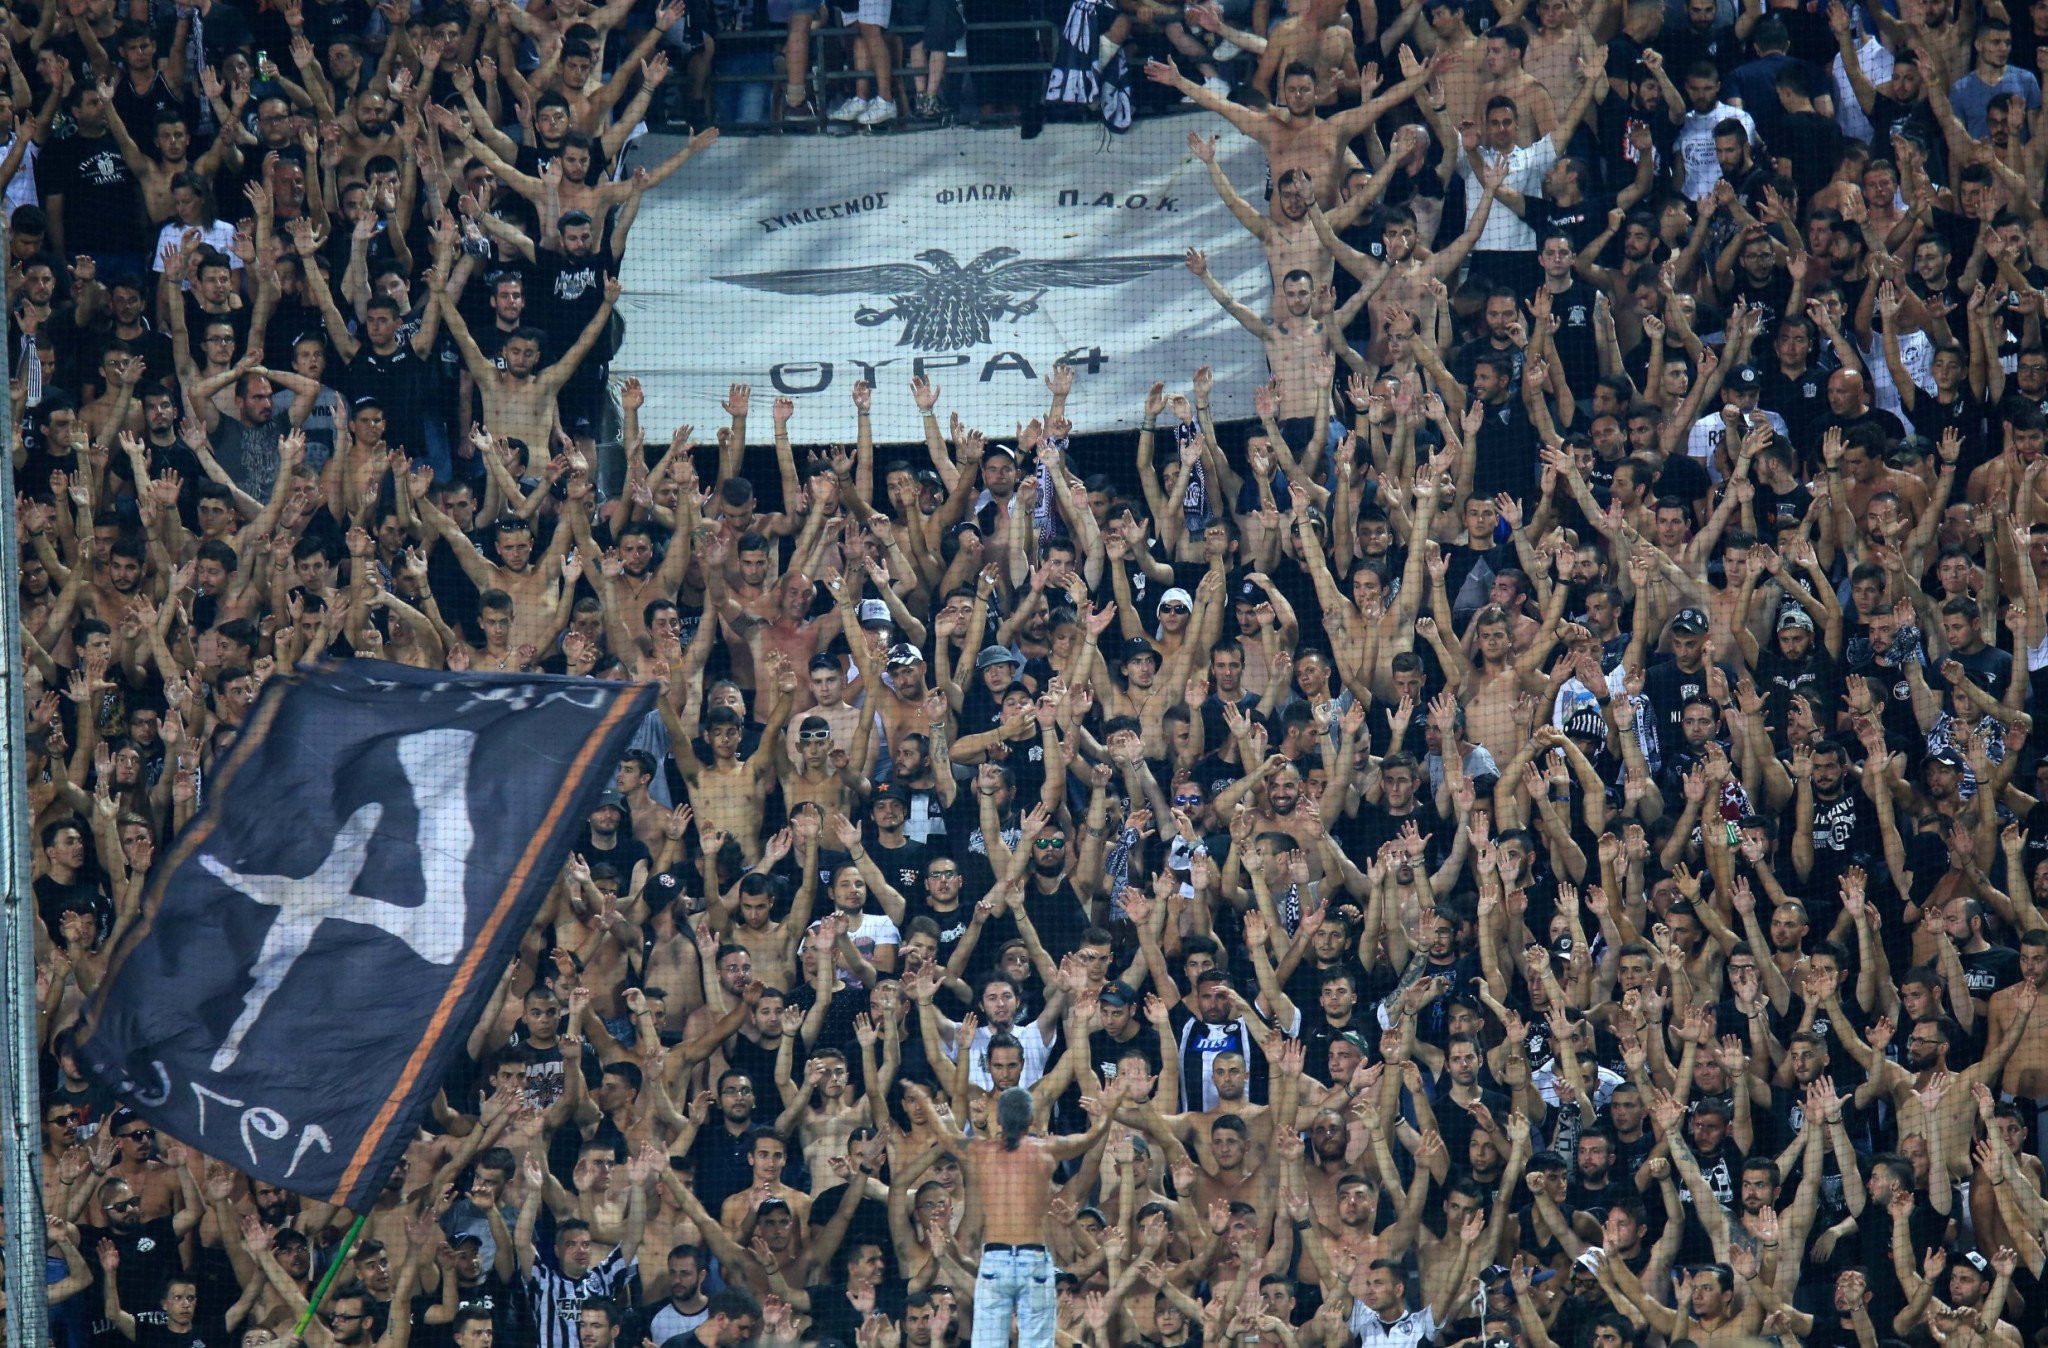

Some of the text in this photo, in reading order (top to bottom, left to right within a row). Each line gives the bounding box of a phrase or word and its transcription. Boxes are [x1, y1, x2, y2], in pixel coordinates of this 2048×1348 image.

[757, 184, 1180, 234] ΣΥΝΔΕΣΜΟΣ ΦΙΛΩΝ Π.Α.Ο.Κ.
[769, 346, 1109, 394] ΘΥΡΑ 4
[1834, 824, 1852, 842] 61
